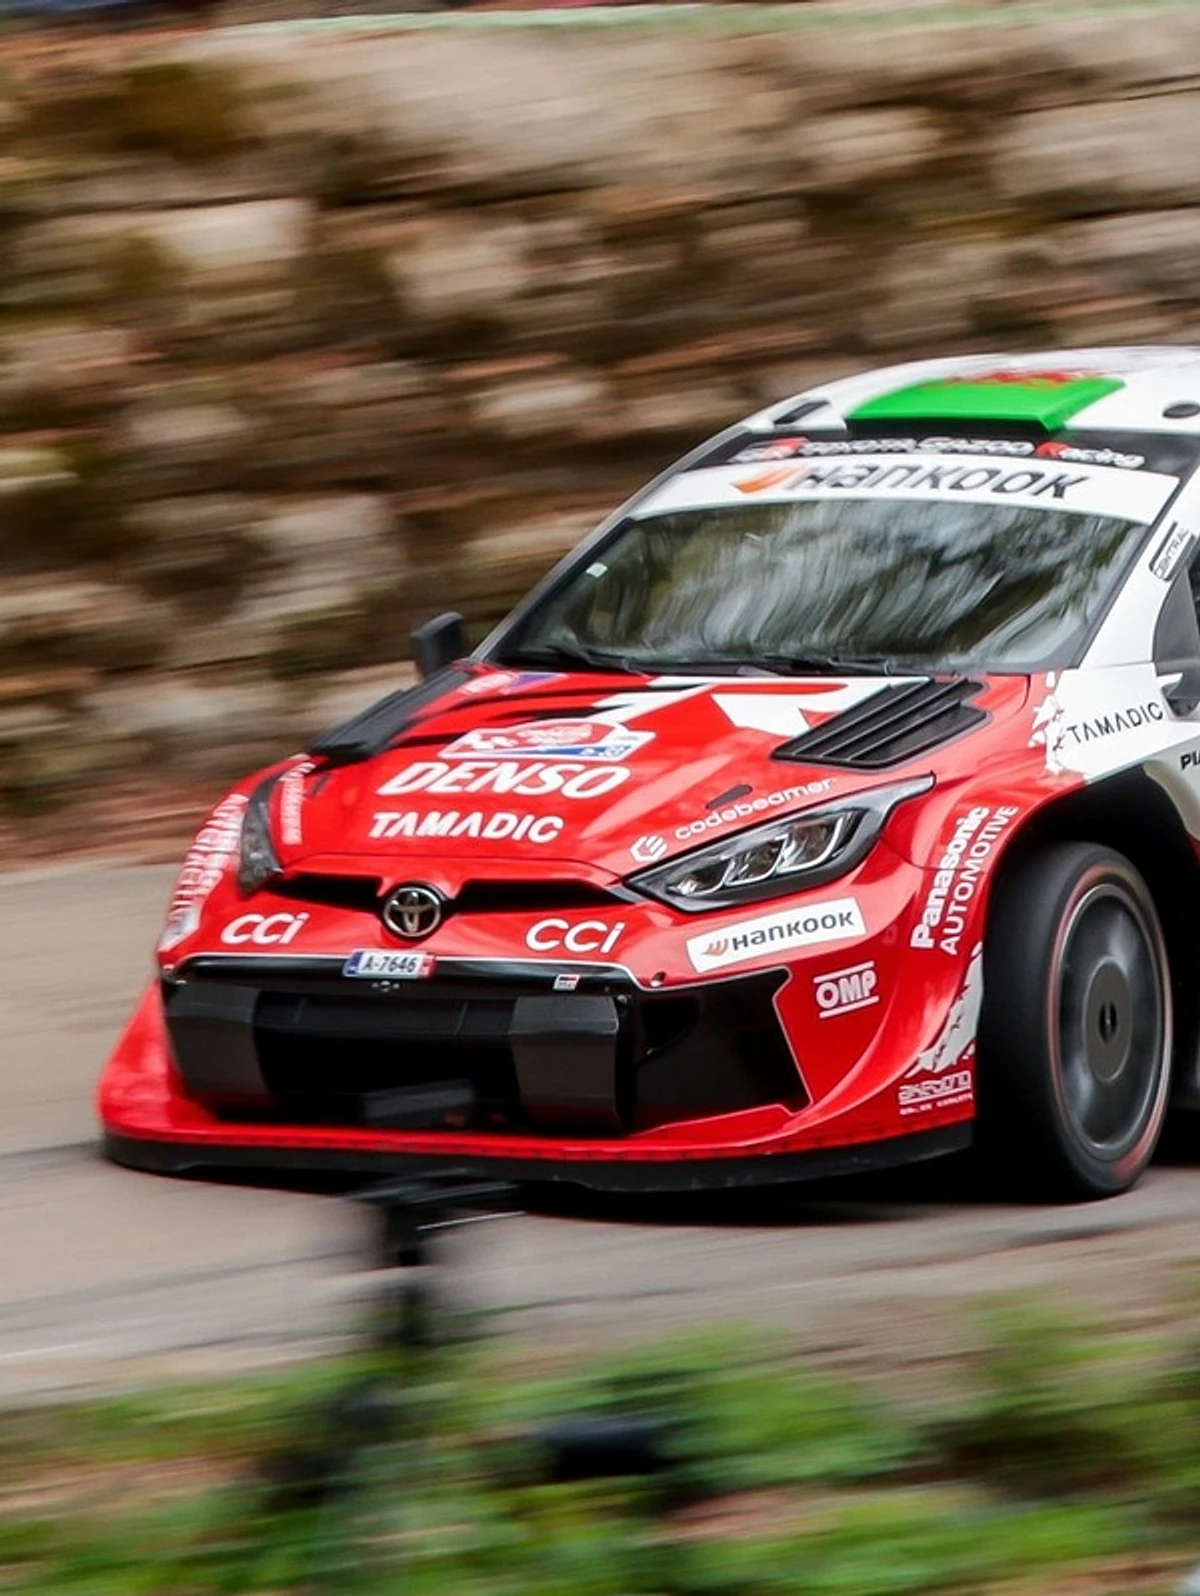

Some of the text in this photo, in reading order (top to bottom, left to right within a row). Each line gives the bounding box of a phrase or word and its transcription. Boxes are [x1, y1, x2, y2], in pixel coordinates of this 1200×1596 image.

[1067, 701, 1164, 743] TAMADIC
[376, 761, 632, 799] DENSO
[368, 811, 564, 843] TAMADIC
[675, 777, 834, 841] codebeamer
[910, 806, 990, 949] Panasonic
[940, 805, 1019, 956] AUTOMOTIVE
[363, 956, 418, 974] A-7646
[815, 969, 878, 1009] OMP
